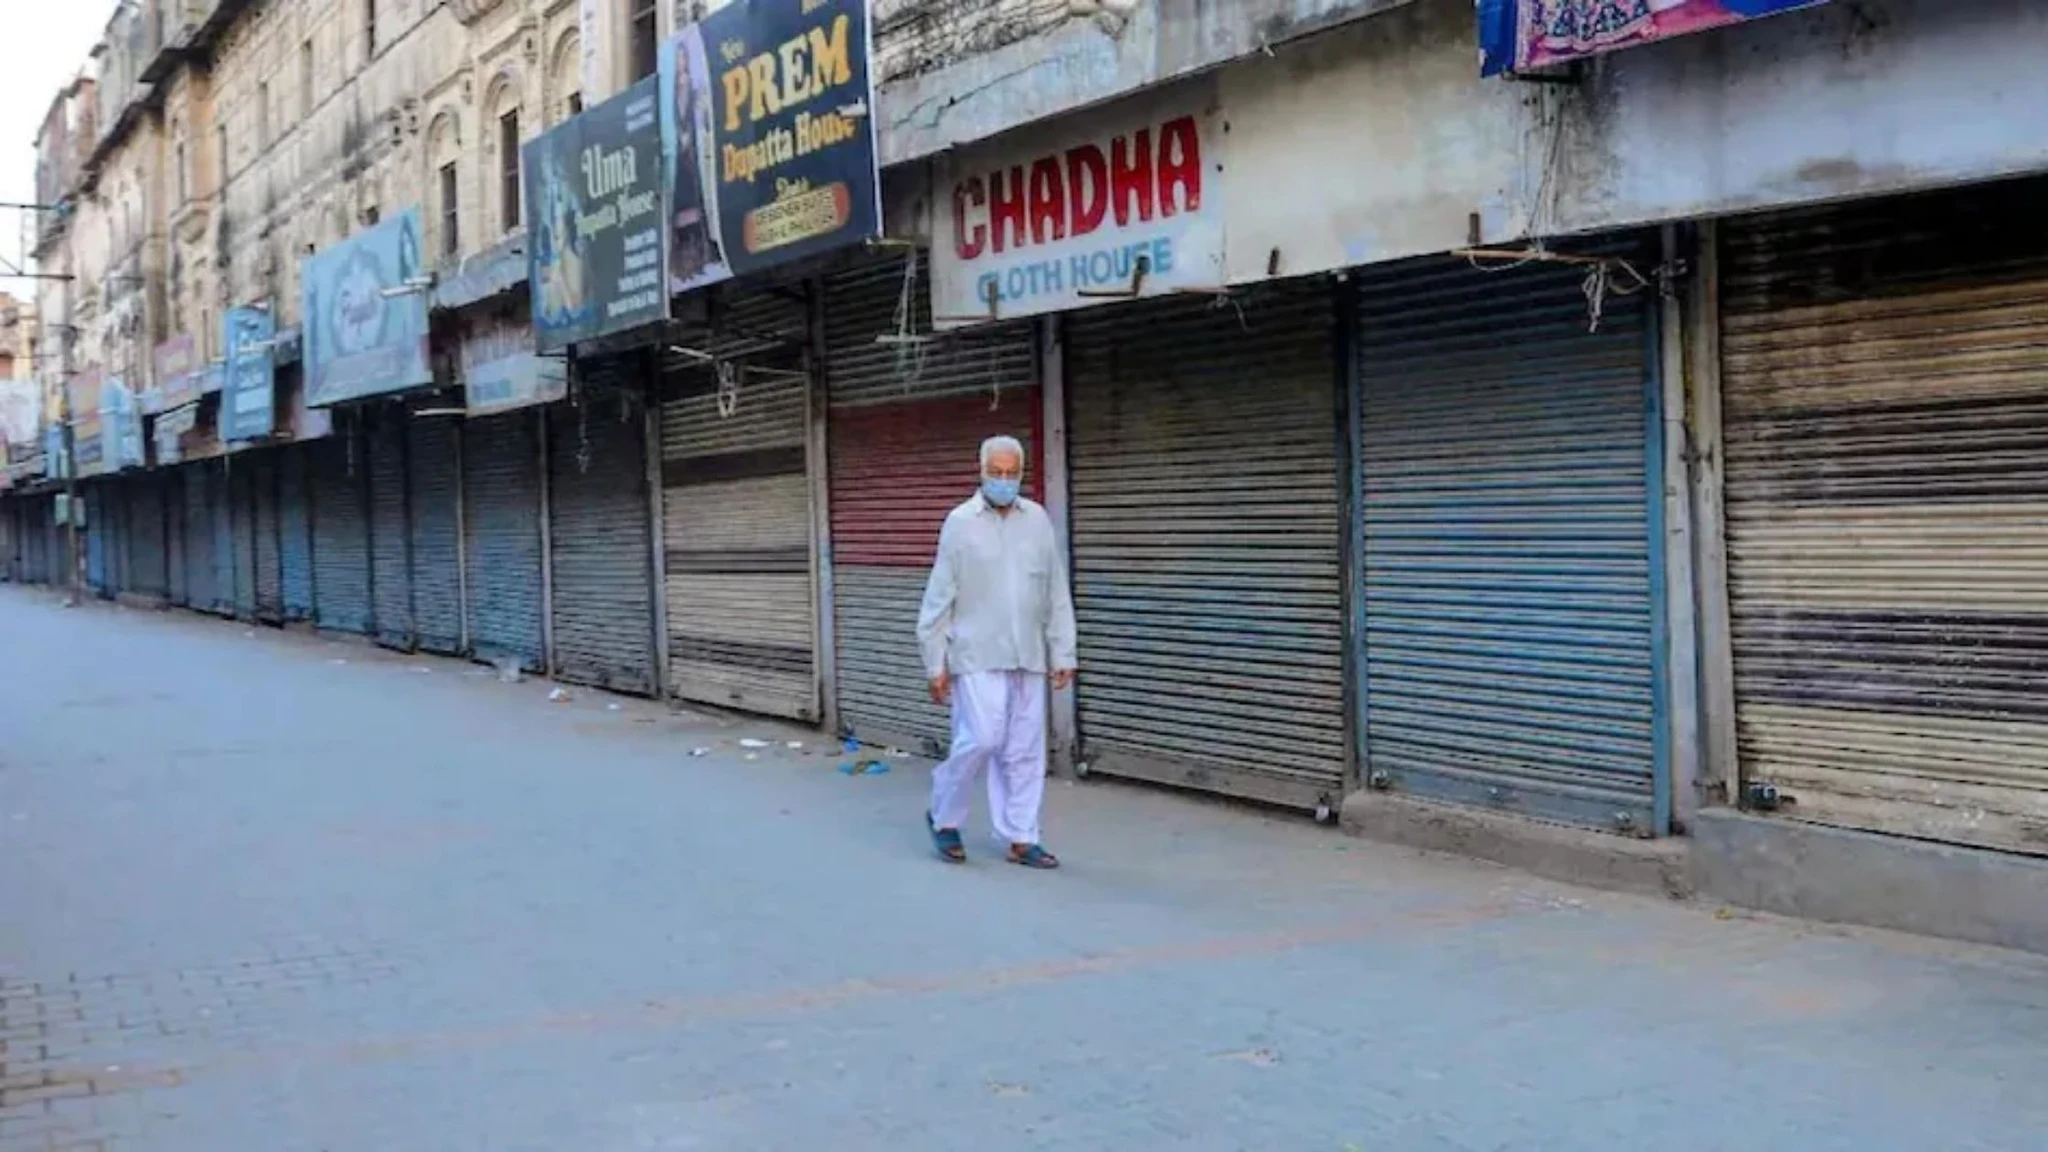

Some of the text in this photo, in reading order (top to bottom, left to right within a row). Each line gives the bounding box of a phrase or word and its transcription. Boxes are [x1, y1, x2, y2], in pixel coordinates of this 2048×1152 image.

[723, 15, 851, 131] PREM
[582, 145, 636, 198] Uma
[722, 111, 856, 183] Dupatta House
[954, 116, 1201, 259] CHADHA
